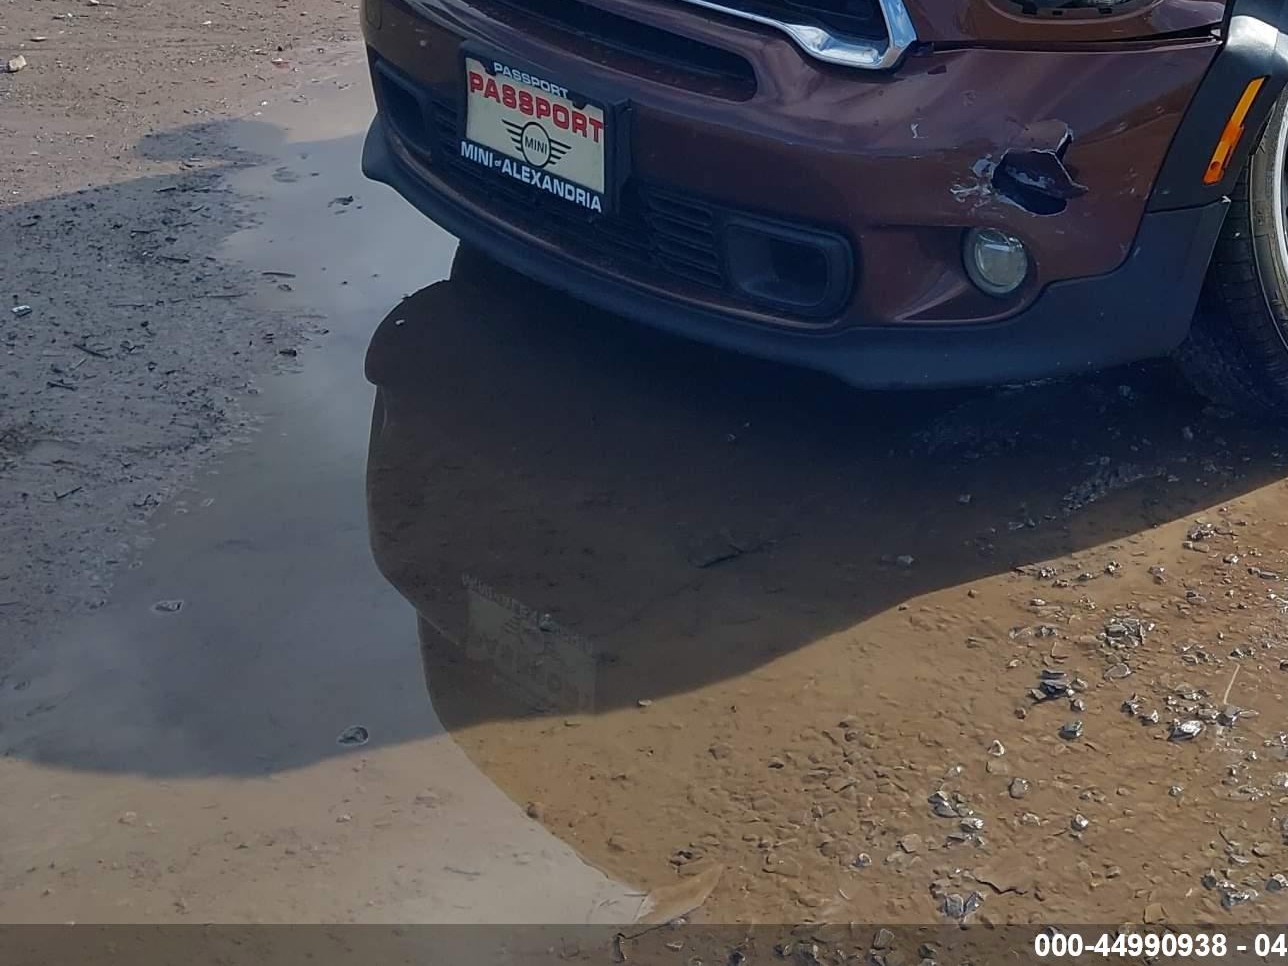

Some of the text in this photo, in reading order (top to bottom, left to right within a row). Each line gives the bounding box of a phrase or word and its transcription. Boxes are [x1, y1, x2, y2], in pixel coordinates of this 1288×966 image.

[469, 71, 603, 143] PASSPORT
[493, 62, 569, 99] PASSPORT
[524, 136, 548, 155] MINI
[460, 141, 602, 213] MINI of ALEXANDRIA
